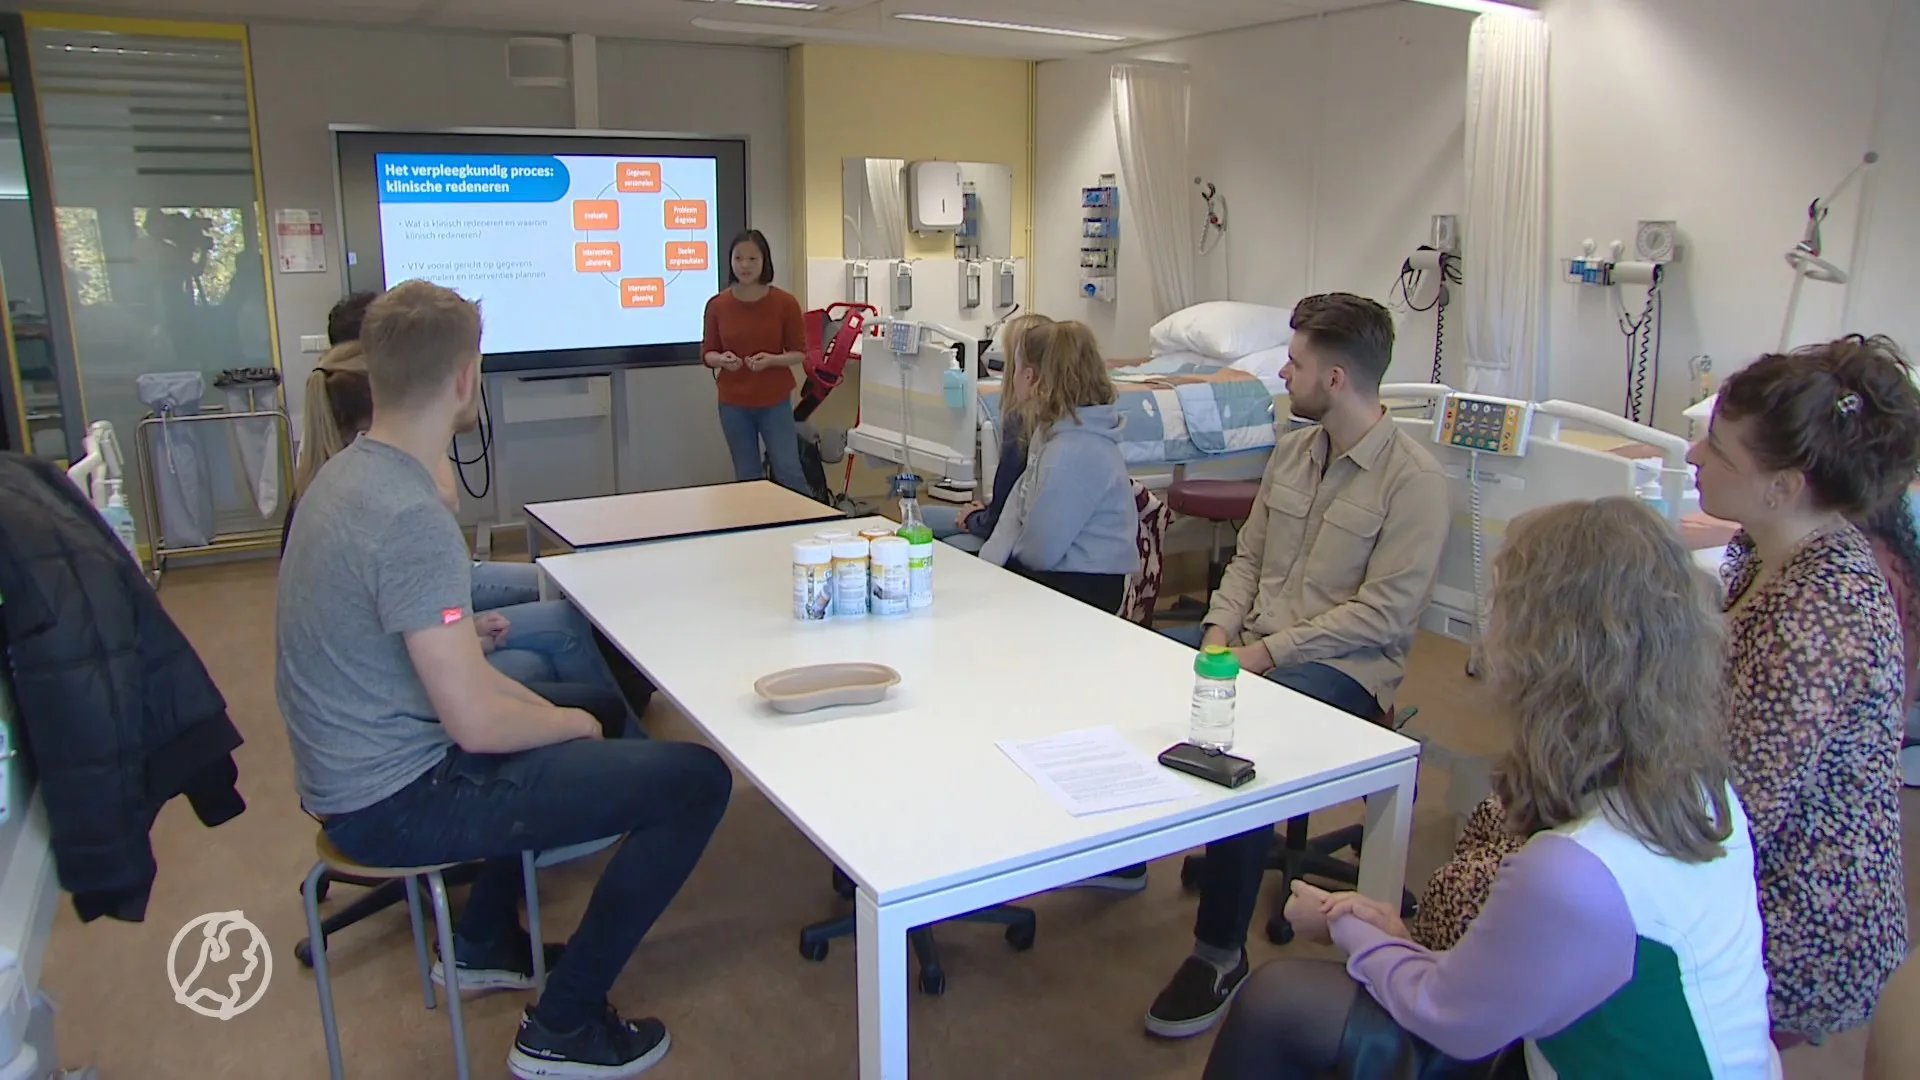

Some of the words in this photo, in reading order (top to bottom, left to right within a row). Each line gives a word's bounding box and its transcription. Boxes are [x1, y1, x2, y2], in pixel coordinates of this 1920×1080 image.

[385, 163, 408, 177] Het
[411, 163, 508, 179] verpleegkundig
[511, 165, 554, 179] proces:
[386, 180, 442, 193] klinische
[446, 181, 510, 193] redeneren
[673, 206, 698, 214] Probleem
[405, 219, 421, 229] Wat
[423, 219, 430, 228] is
[432, 219, 461, 228] klinisch
[464, 219, 504, 229] redeneren
[517, 219, 548, 227] waarom
[405, 231, 436, 240] klinisch
[438, 230, 482, 241] redeneren?
[427, 261, 452, 270] vooral
[454, 261, 481, 272] gericht
[483, 261, 495, 271] op
[496, 260, 533, 270] gegevens
[468, 271, 514, 280] interventies
[515, 270, 546, 280] plannen
